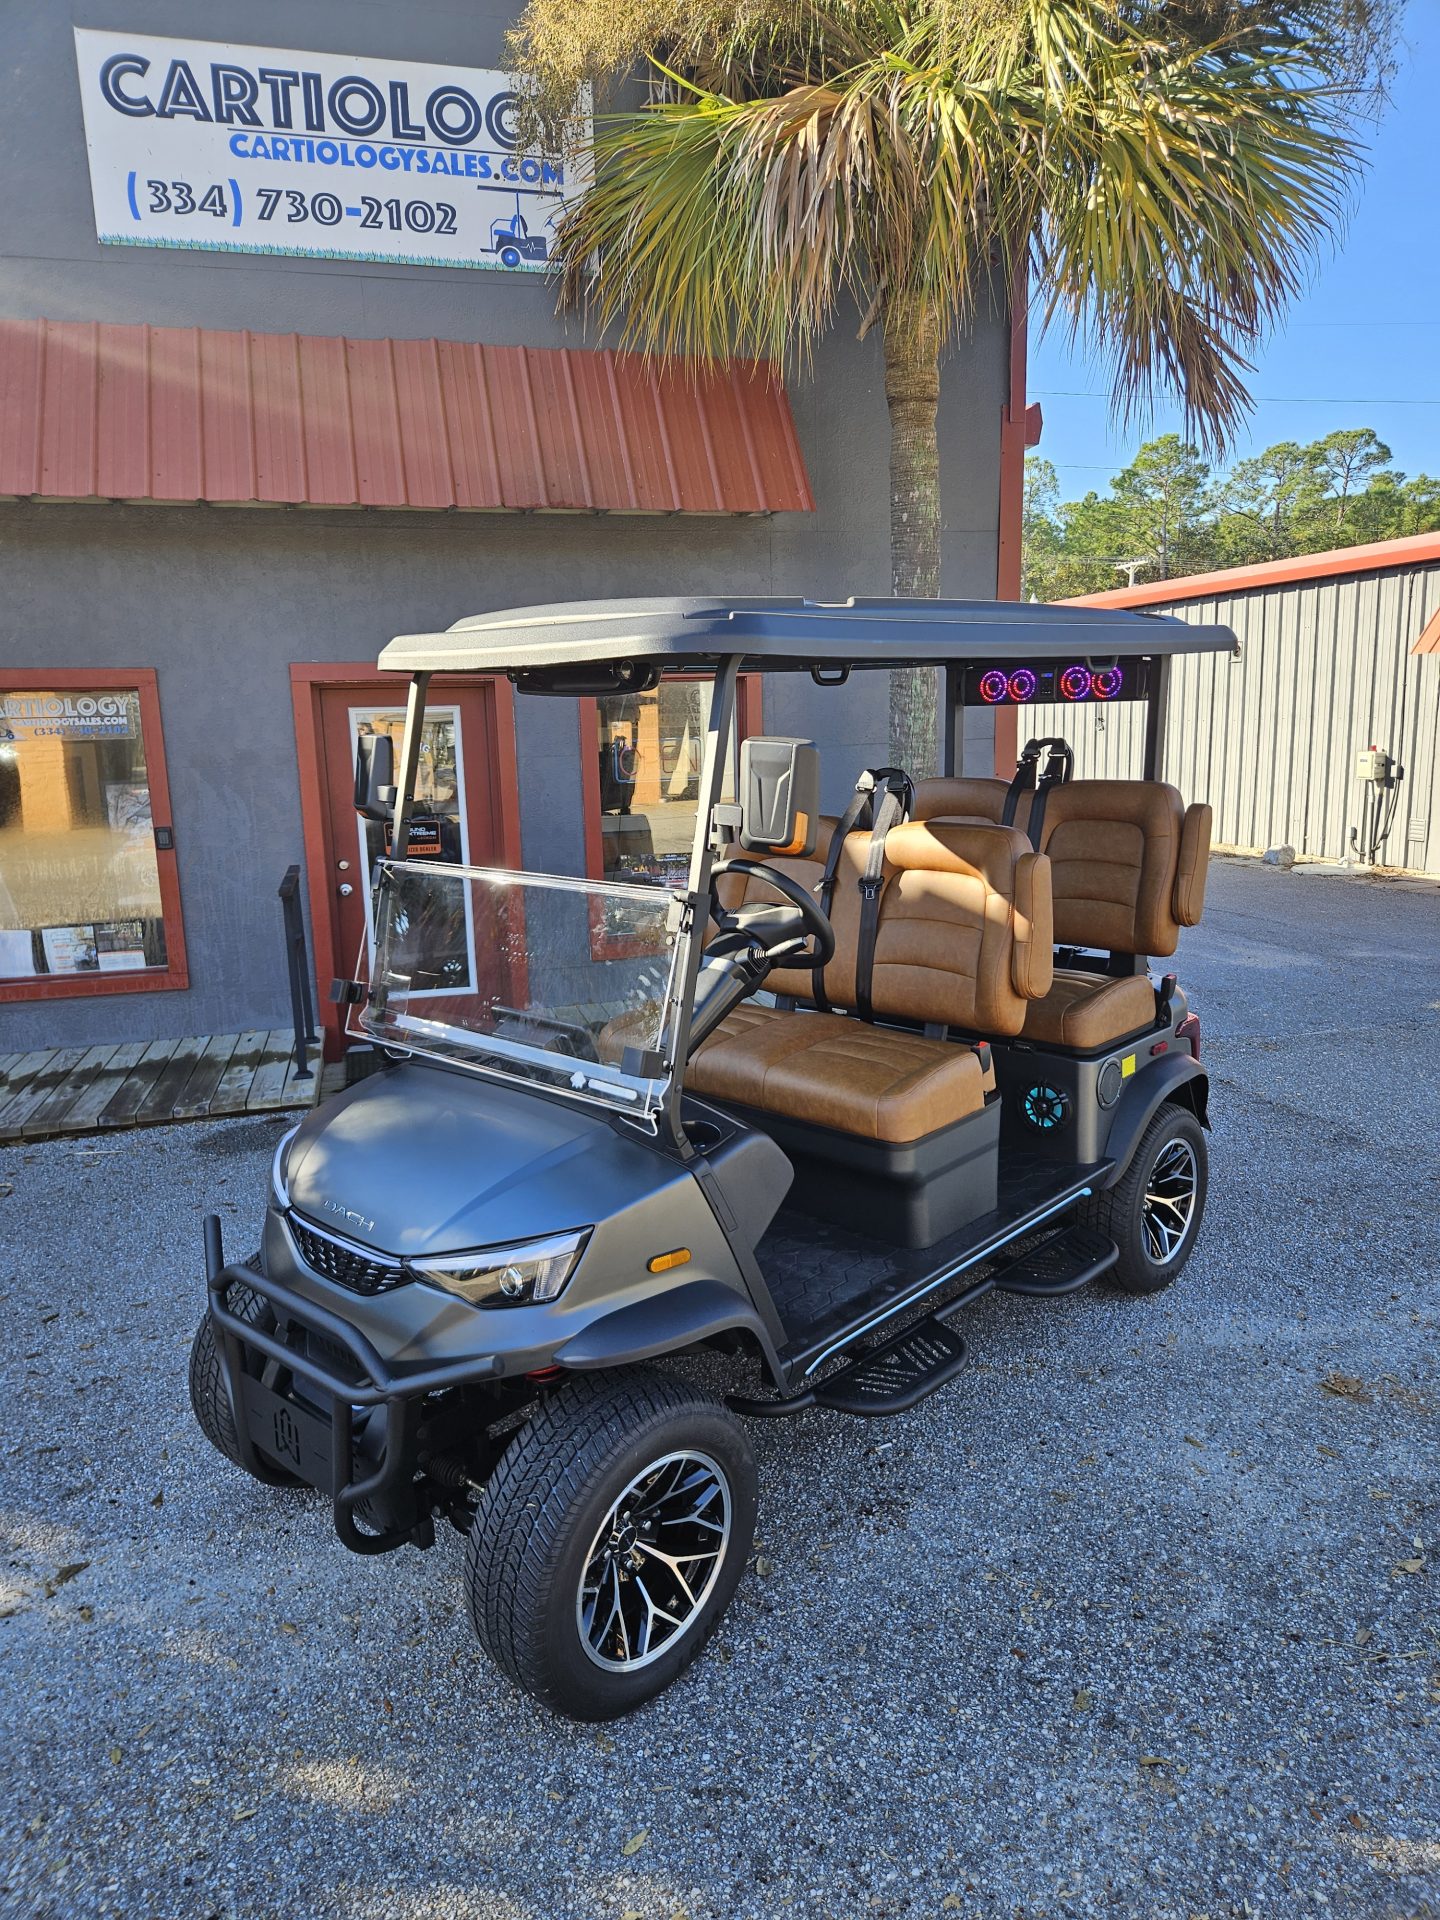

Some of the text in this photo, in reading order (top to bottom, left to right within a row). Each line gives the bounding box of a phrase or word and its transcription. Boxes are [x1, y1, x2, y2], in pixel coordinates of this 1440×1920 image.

[100, 53, 564, 153] CARTIOLOG
[228, 134, 564, 185] CARTIOLOGYSALES.COM
[127, 172, 457, 234] (334) 730-2102
[34, 727, 65, 735] (334)
